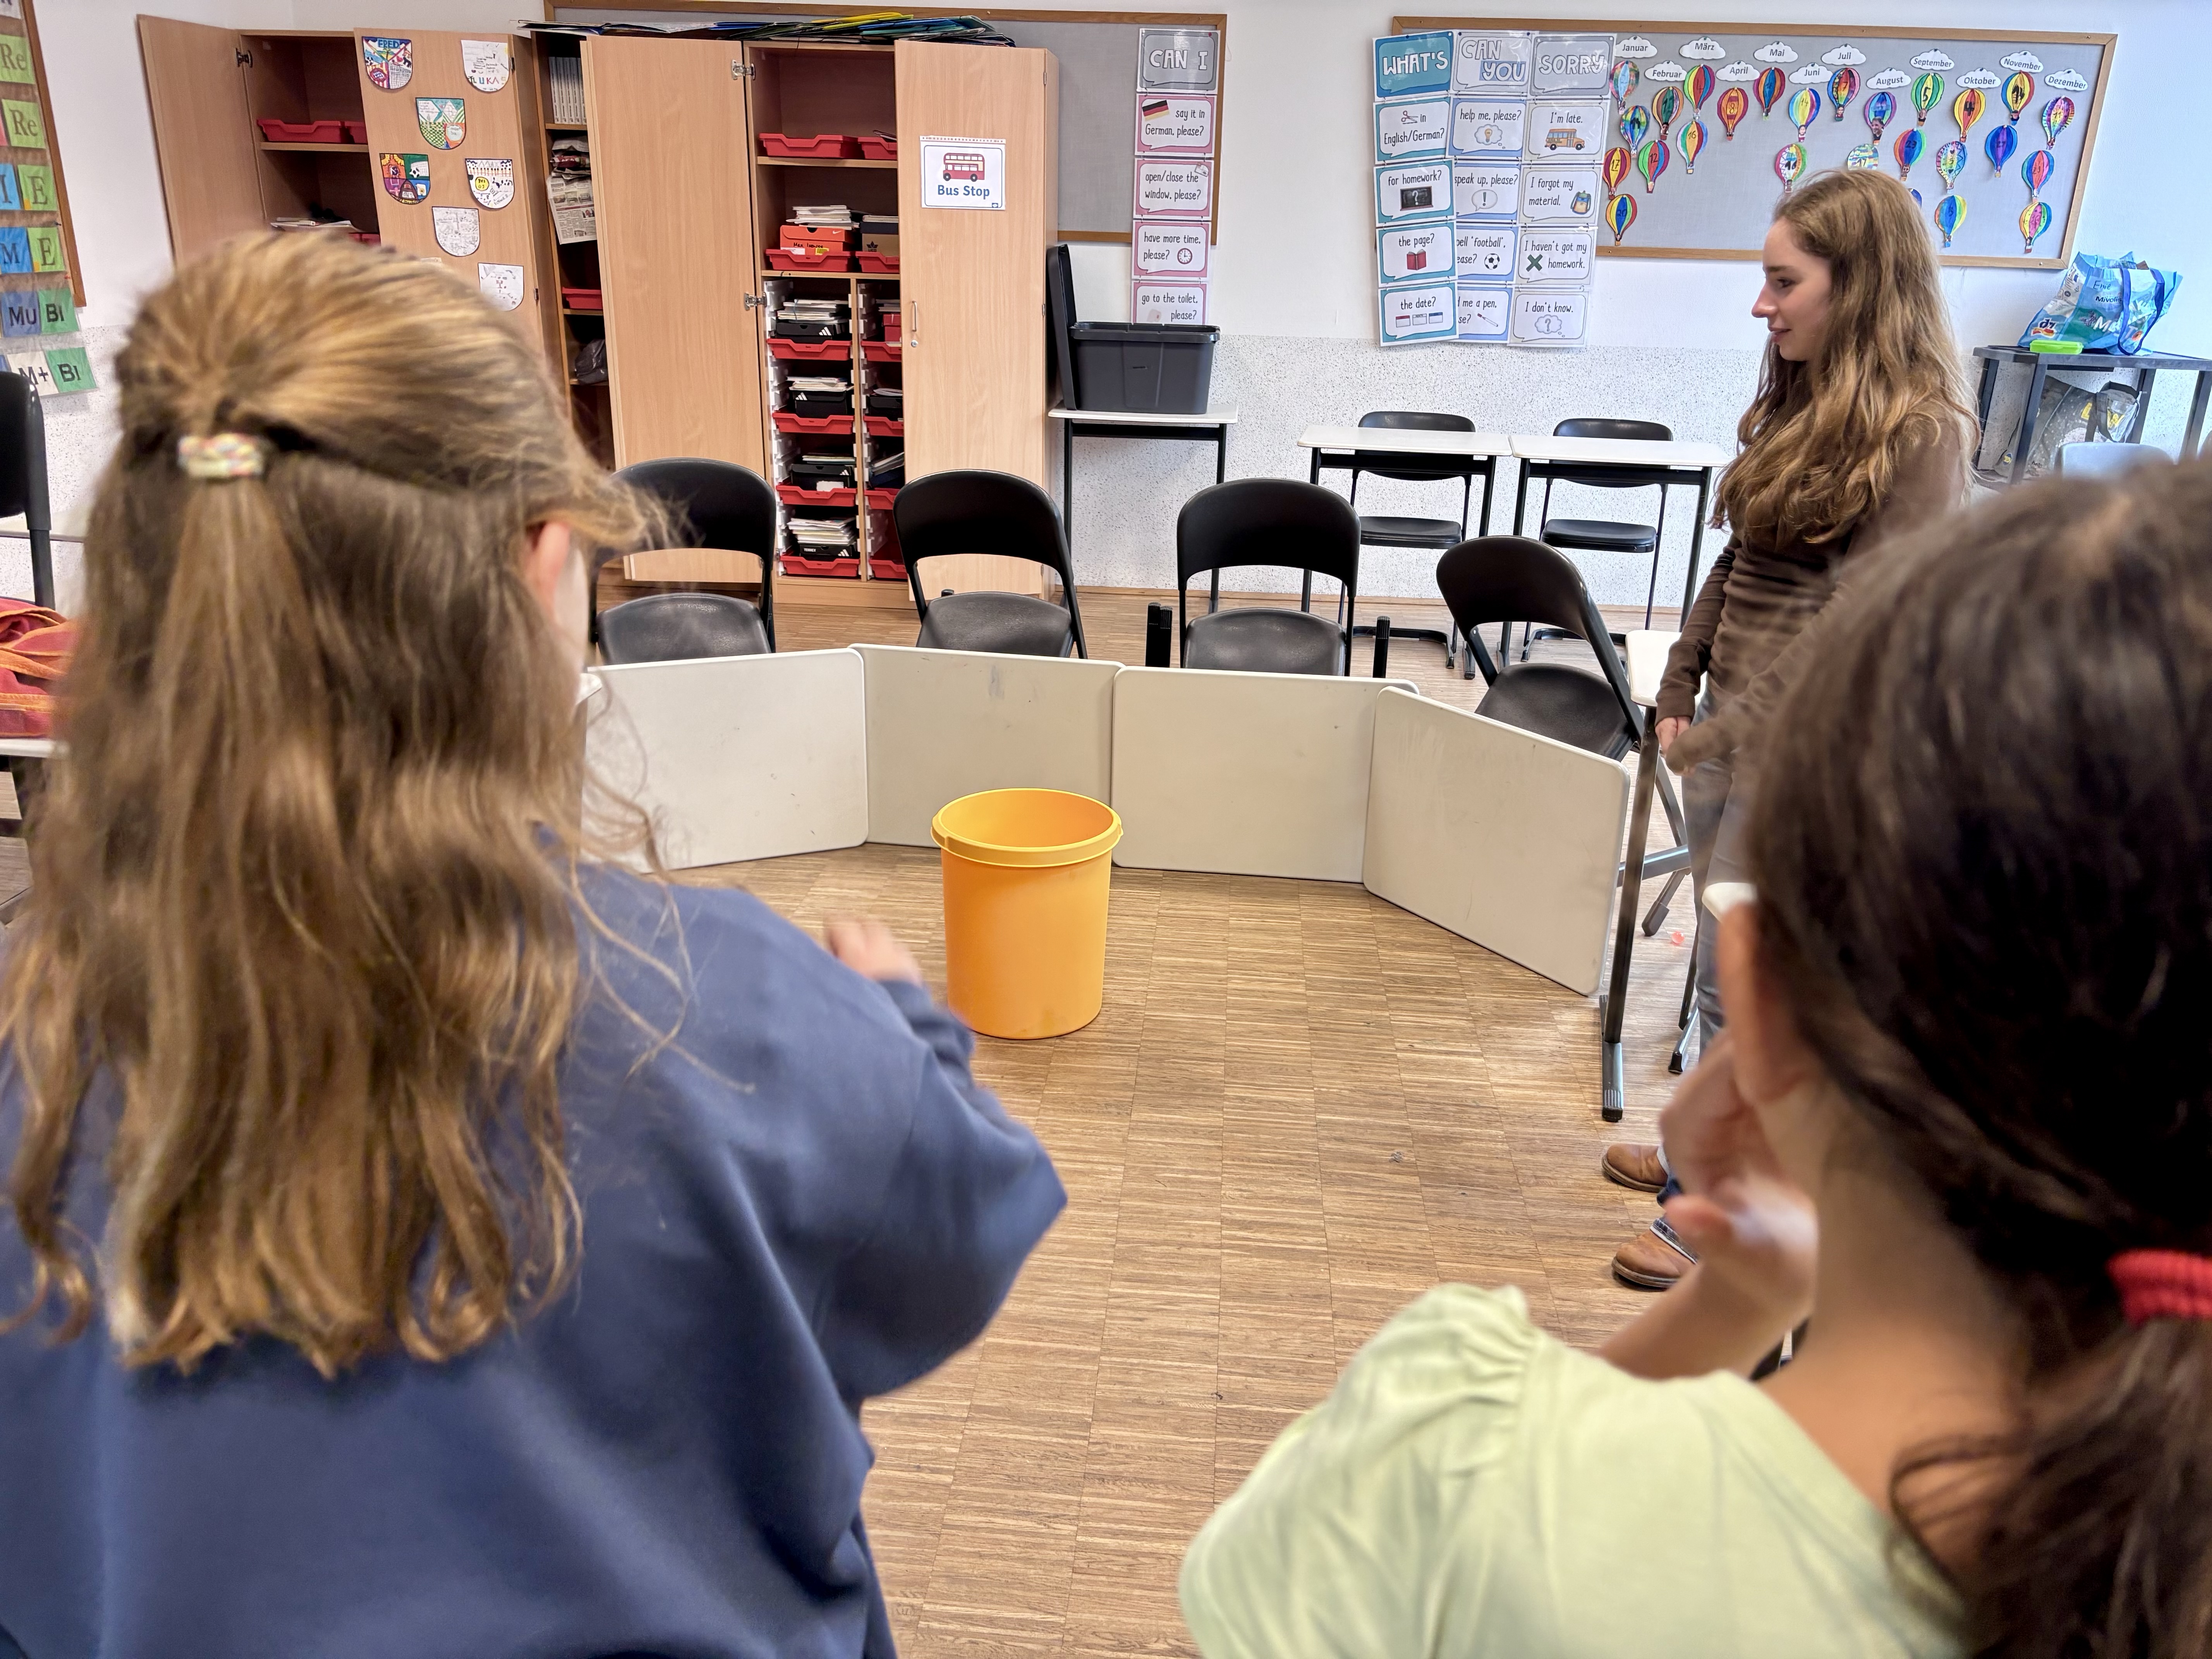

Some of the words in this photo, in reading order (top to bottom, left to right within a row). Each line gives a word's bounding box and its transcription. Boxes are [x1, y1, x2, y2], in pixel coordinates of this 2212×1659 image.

[378, 40, 399, 48] FRED
[1461, 40, 1501, 60] CAN
[1695, 43, 1714, 51] März
[1149, 49, 1187, 69] CAN
[1199, 50, 1208, 70] I
[1383, 51, 1448, 76] WHAT'S
[1539, 55, 1605, 75] SORRY
[1914, 58, 1952, 68] September
[2004, 58, 2041, 71] November
[1482, 61, 1526, 82] YOU
[1652, 70, 1682, 78] Februar
[1730, 67, 1748, 75] April
[1697, 79, 1703, 93] 4
[1876, 77, 1903, 86] August
[1964, 77, 1996, 85] Oktober
[2048, 76, 2087, 89] Dezember
[1176, 110, 1188, 121] say
[1191, 110, 1196, 118] it
[1199, 110, 1205, 118] in
[1420, 114, 1426, 123] in
[1460, 108, 1475, 121] help
[1493, 109, 1521, 122] please?
[1550, 112, 1563, 124] I'm
[1567, 113, 1583, 124] late.
[9, 108, 38, 137] Re
[1177, 125, 1204, 138] please?
[1384, 127, 1444, 146] English/German?
[1688, 131, 1697, 140] 16
[1611, 159, 1620, 170] 17
[1650, 153, 1658, 163] 12
[1146, 170, 1183, 185] open/close
[1187, 172, 1198, 183] the
[1388, 175, 1399, 186] for
[1402, 170, 1442, 184] homework?
[1455, 175, 1474, 189] speak
[1491, 175, 1518, 189] please?
[27, 176, 48, 205] E
[1530, 178, 1534, 188] I
[1538, 179, 1560, 191] forgot
[1563, 180, 1573, 191] my
[938, 185, 959, 196] Bus
[963, 185, 990, 200] Stop
[1175, 189, 1201, 202] please?
[1529, 195, 1561, 206] material.
[1144, 232, 1160, 243] have
[1163, 235, 1180, 243] more
[1399, 236, 1411, 247] the
[1413, 233, 1434, 248] page?
[0, 243, 20, 264] M
[37, 237, 56, 266] E
[1525, 240, 1528, 251] I
[1531, 241, 1559, 252] haven't
[1561, 242, 1573, 254] got
[1576, 243, 1587, 254] my
[1144, 250, 1170, 262] please?
[1548, 258, 1585, 270] homework.
[1142, 295, 1149, 305] go
[1153, 294, 1160, 303] to
[1163, 293, 1175, 304] the
[1400, 299, 1414, 310] the
[1416, 297, 1436, 309] date?
[1526, 302, 1529, 312] I
[1532, 302, 1552, 313] don't
[1554, 302, 1573, 313] know.
[1171, 310, 1197, 322] please?
[1458, 314, 1471, 324] se?
